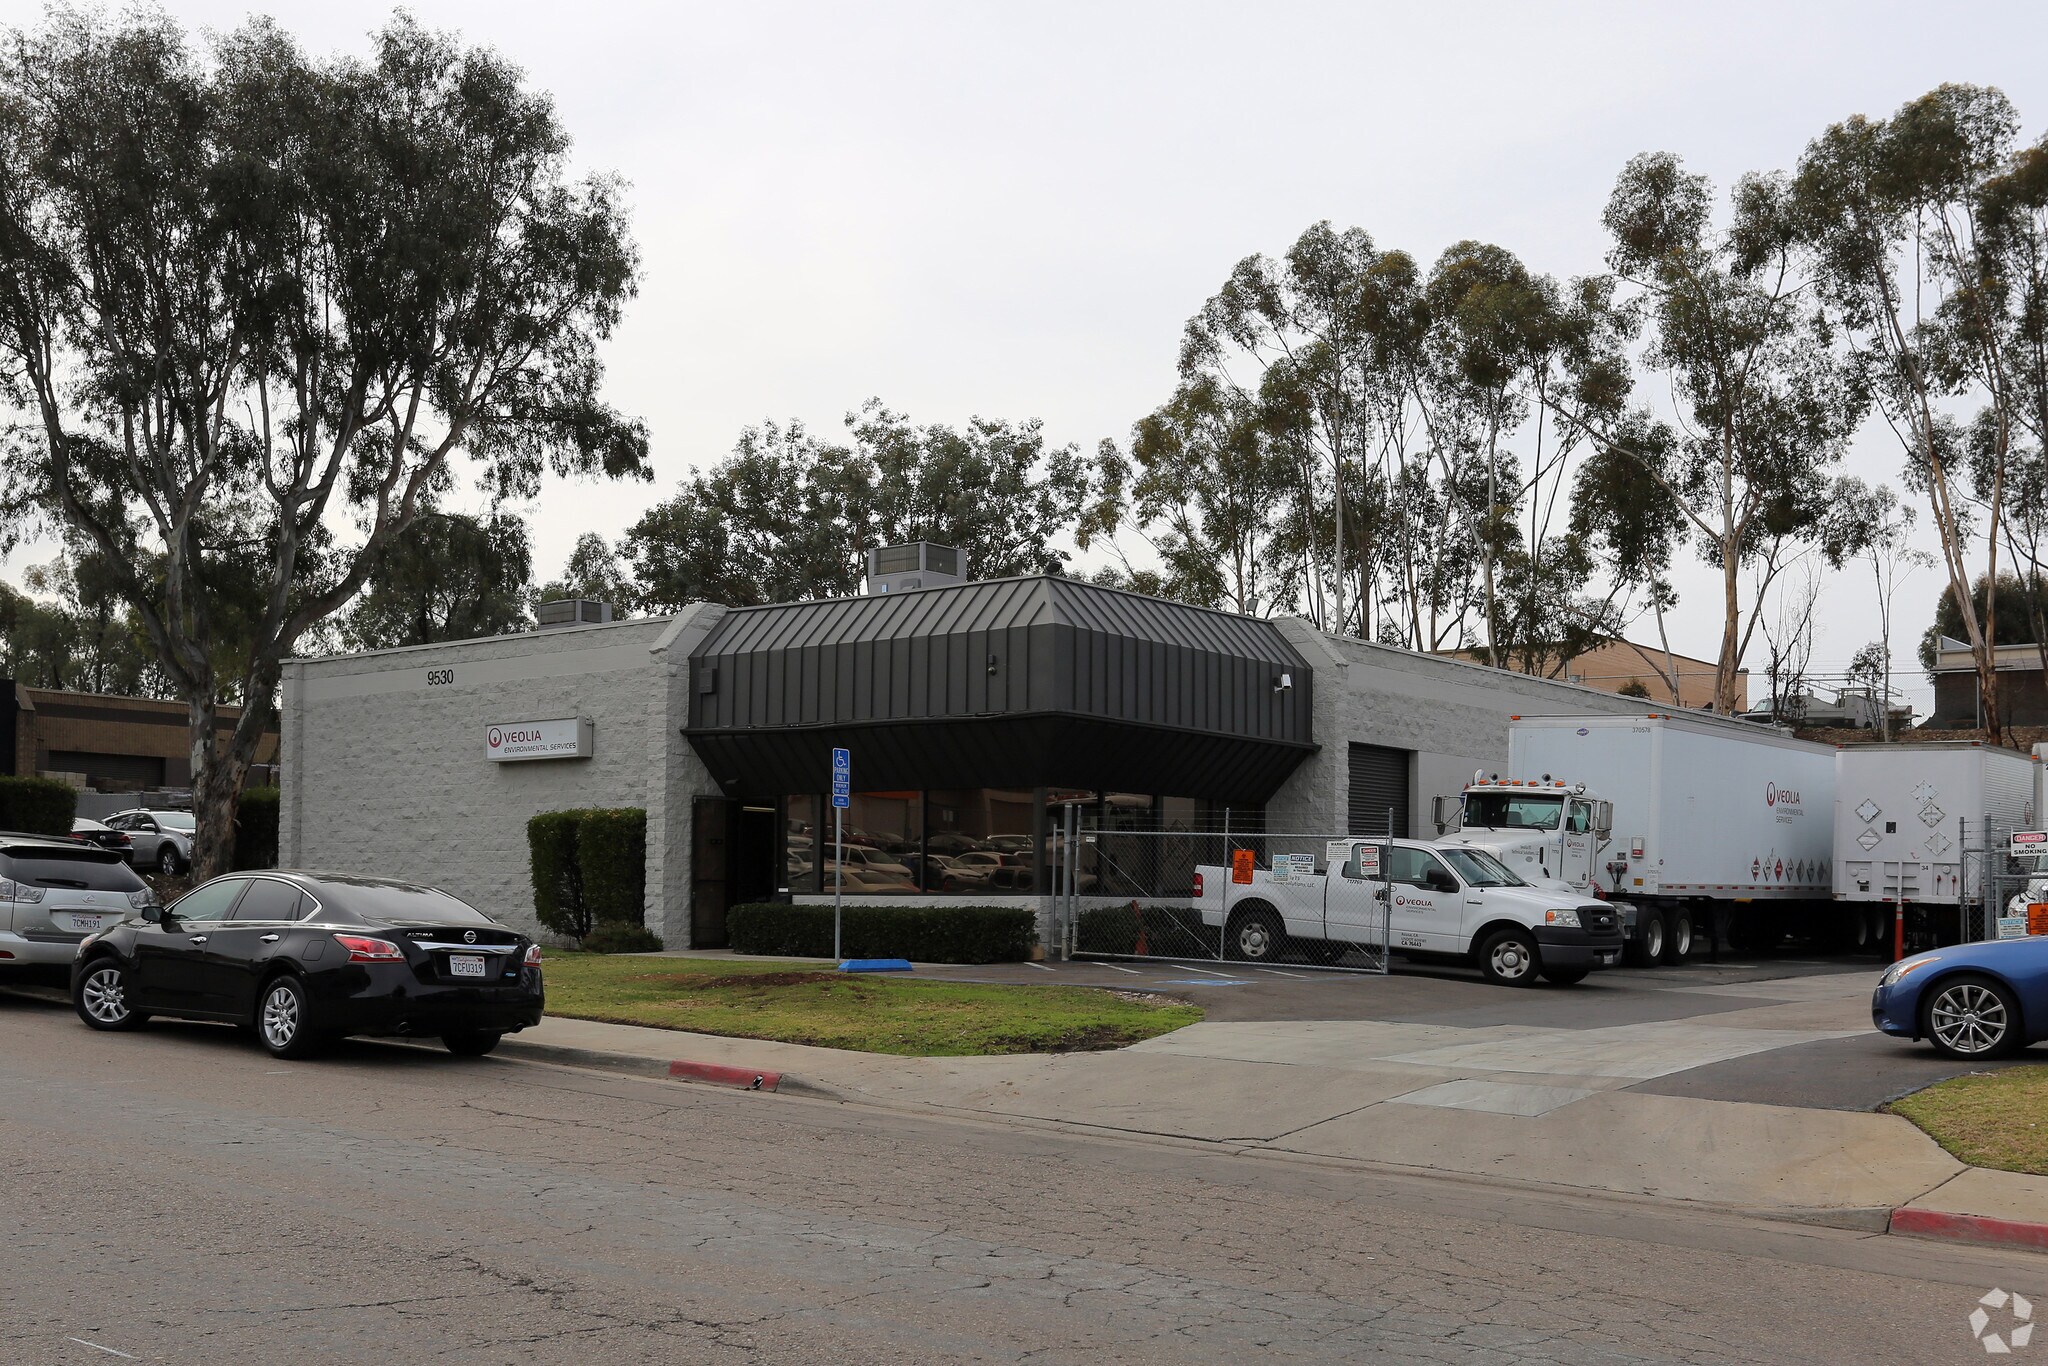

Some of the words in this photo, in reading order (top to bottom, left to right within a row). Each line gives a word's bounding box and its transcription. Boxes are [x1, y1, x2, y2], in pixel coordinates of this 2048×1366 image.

[427, 669, 454, 686] 9530
[503, 730, 542, 744] VEOLIA
[504, 744, 548, 754] ENVIRONMENTAL
[549, 742, 577, 751] SERVICES
[1776, 789, 1801, 805] VEOLIA
[1776, 807, 1804, 816] ENVIRONMENTAL
[1776, 816, 1793, 824] SERVICES
[1406, 898, 1433, 907] VEOLIA
[72, 918, 101, 929] 7CMH191
[452, 962, 483, 974] 7CFU319
